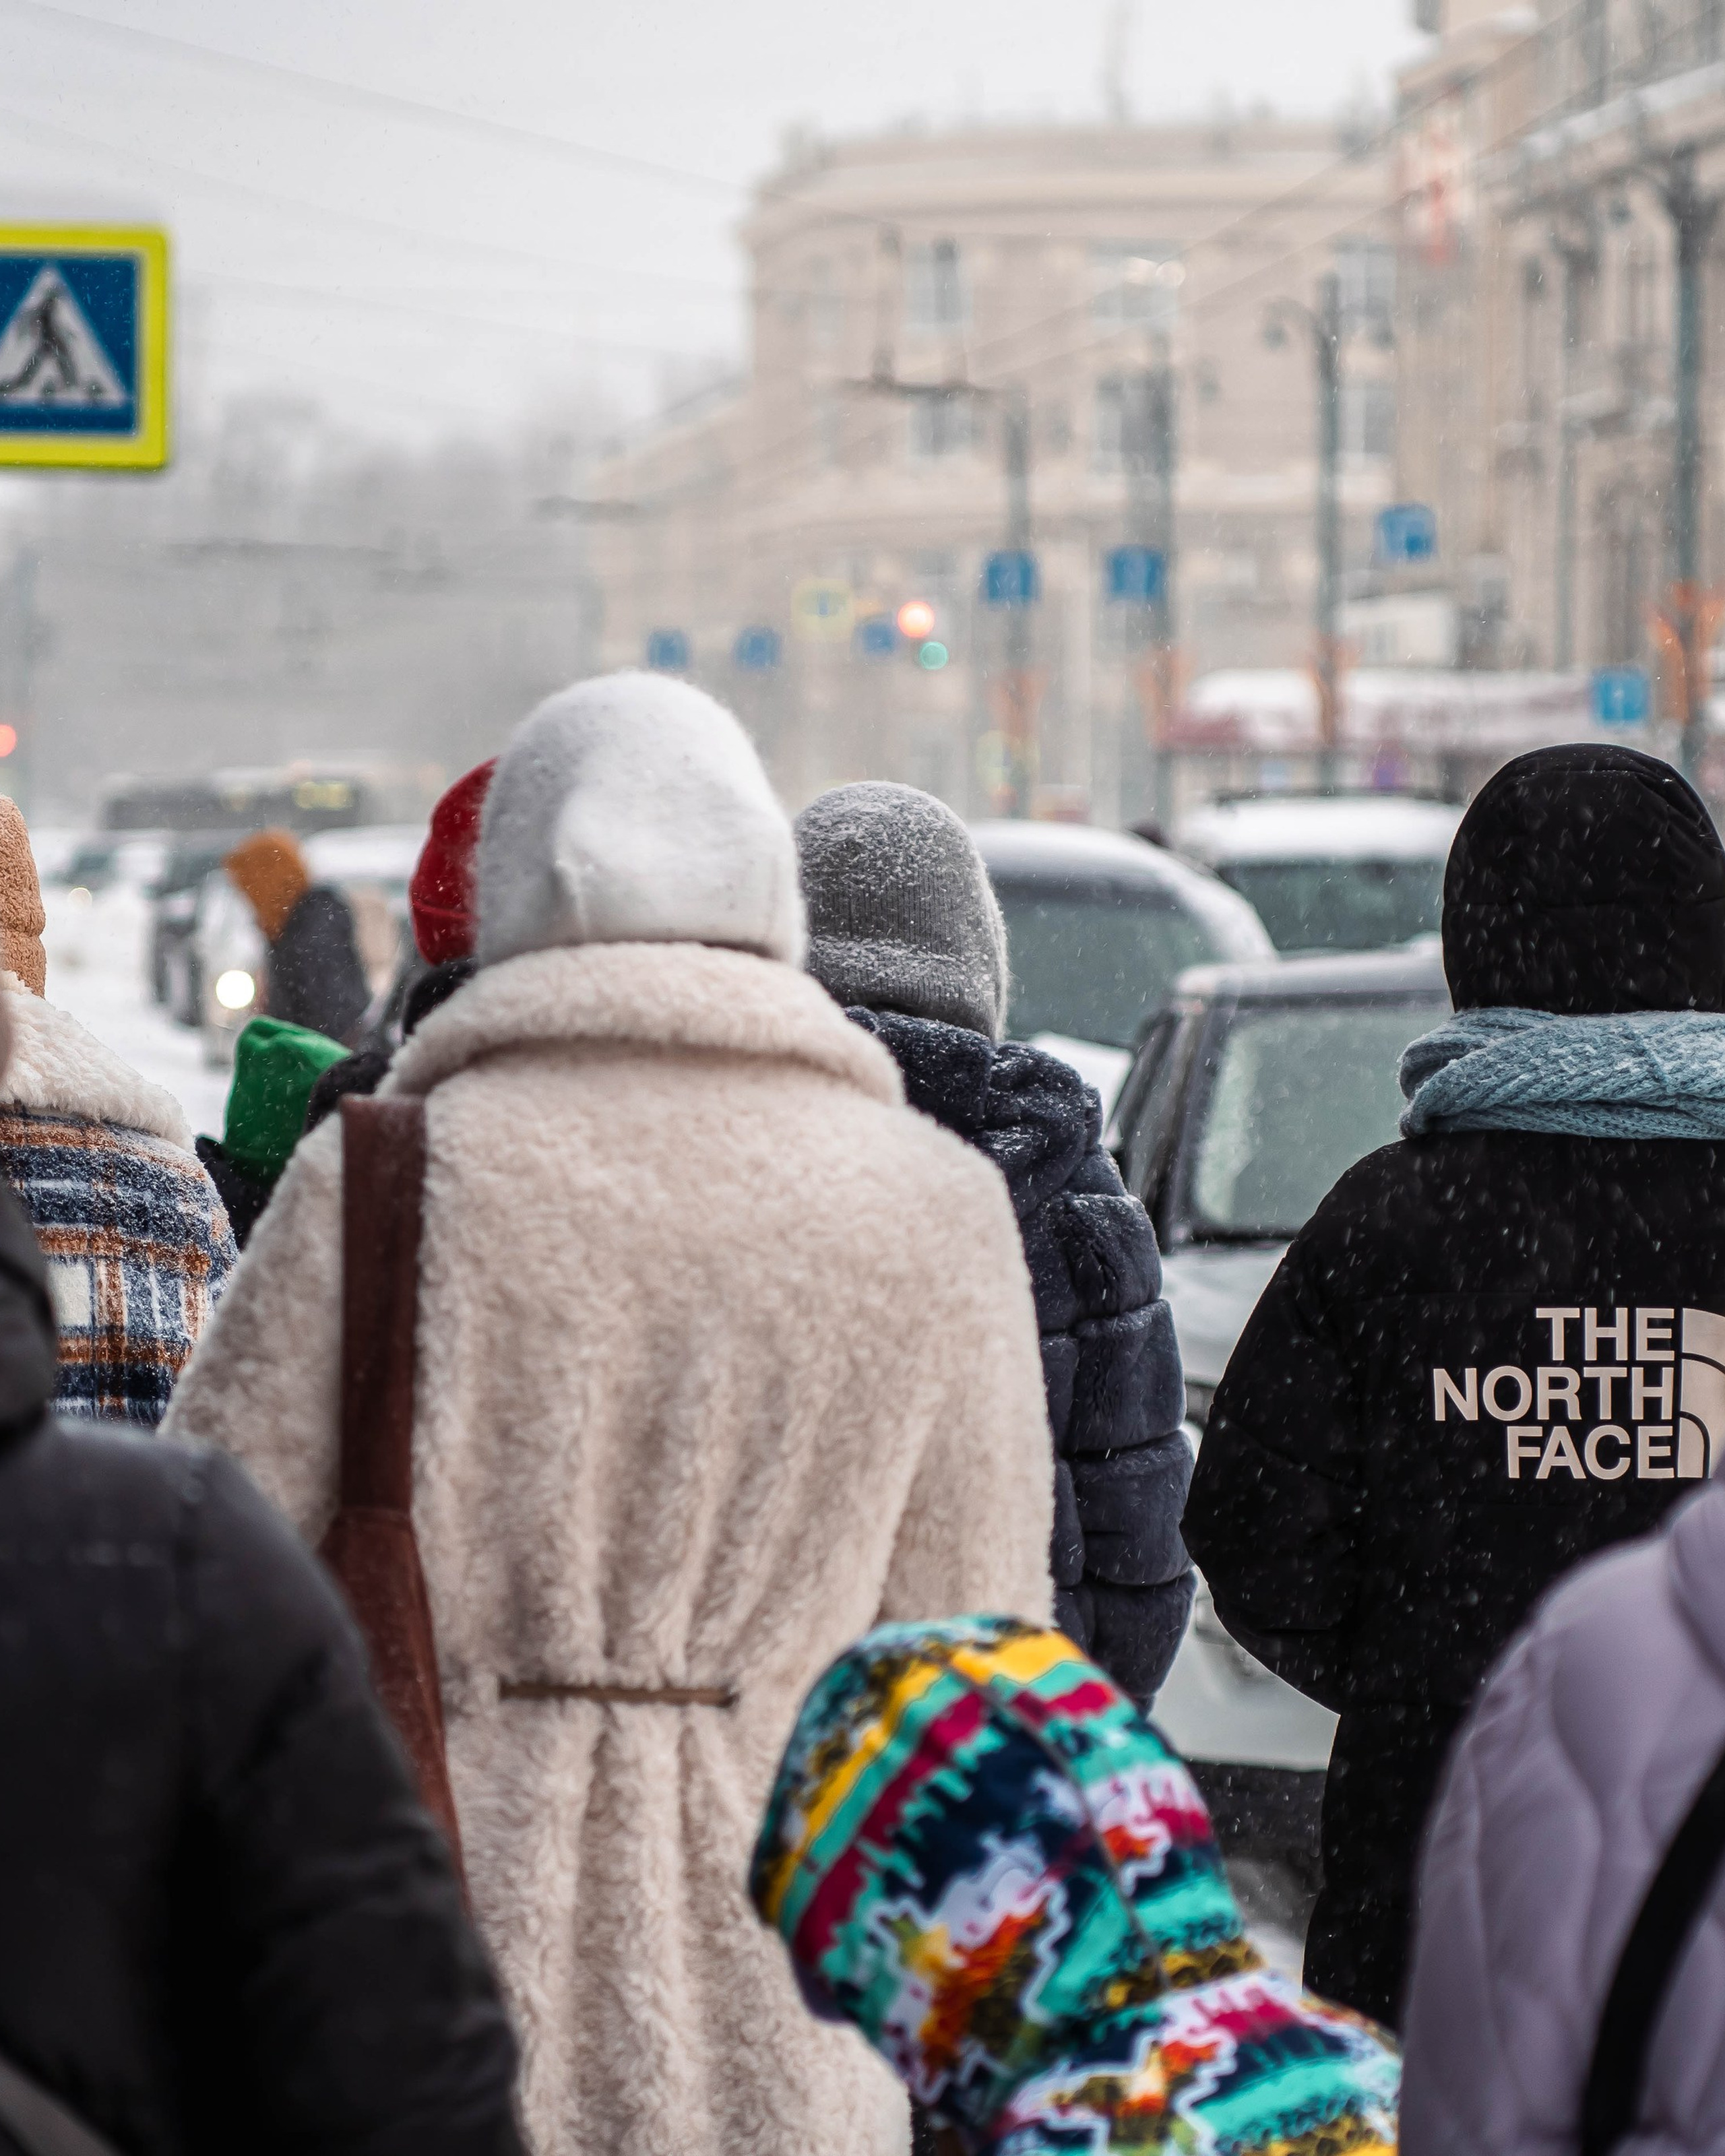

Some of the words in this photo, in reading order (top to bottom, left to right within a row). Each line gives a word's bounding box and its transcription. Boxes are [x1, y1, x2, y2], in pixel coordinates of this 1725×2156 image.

[1536, 1307, 1675, 1361] THE
[1433, 1365, 1674, 1421] NORTH
[1507, 1424, 1675, 1480] FACE
